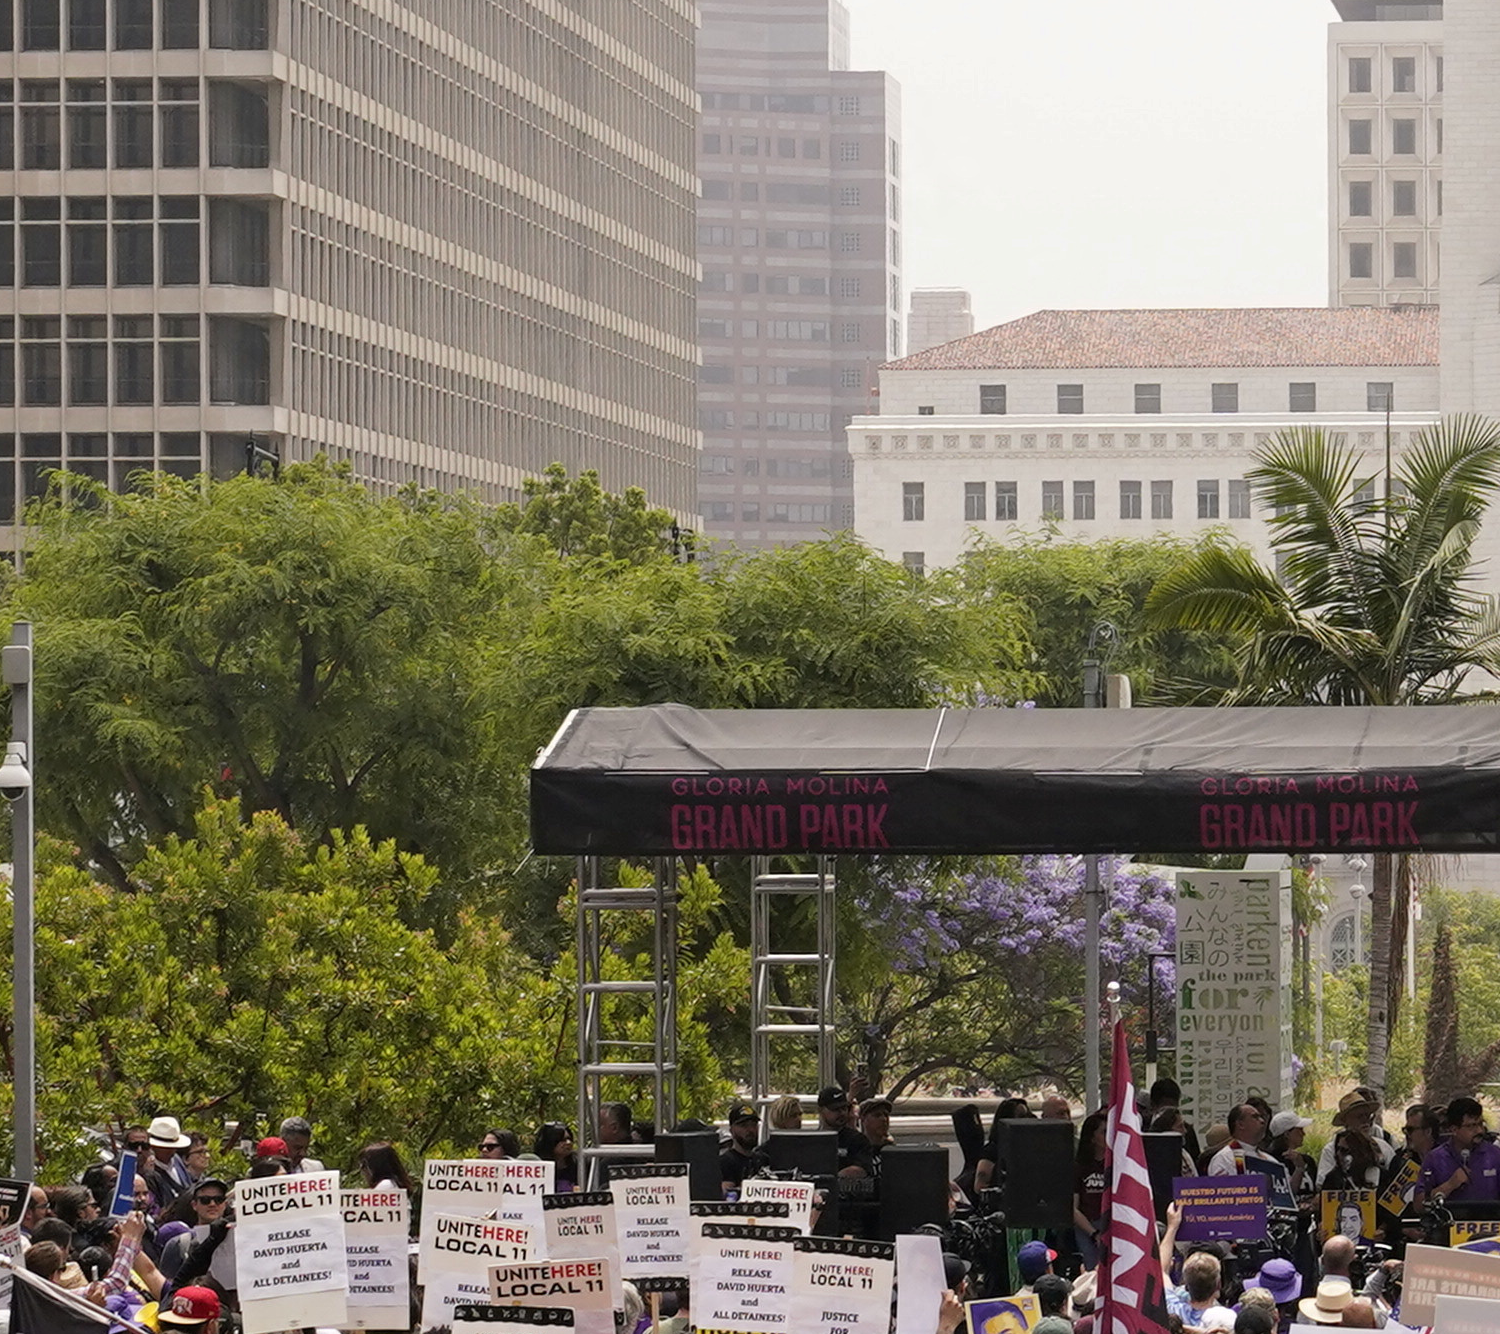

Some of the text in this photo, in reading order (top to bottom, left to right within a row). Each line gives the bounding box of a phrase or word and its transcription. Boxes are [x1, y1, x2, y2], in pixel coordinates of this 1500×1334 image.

[672, 777, 888, 795] GLORIA MOLINA
[1201, 775, 1419, 795] GLORIA MOLINA
[672, 804, 890, 850] GRAND PARK
[1201, 801, 1420, 848] GRAND PARK
[1207, 881, 1230, 967] みんなの
[1179, 908, 1205, 965] 公園
[1198, 968, 1276, 985] the park
[1180, 978, 1249, 1010] for
[427, 1179, 498, 1193] LOCAL 11
[1180, 1188, 1215, 1196] NUESTRO
[1217, 1187, 1247, 1195] FUTURO
[1382, 1167, 1415, 1204] FREE
[242, 1194, 332, 1216] LOCAL 11
[625, 1194, 676, 1206] LOCAL 11
[268, 1229, 311, 1242] RELEASE
[557, 1223, 604, 1236] LOCAL 11
[1456, 1223, 1500, 1235] FREE
[253, 1242, 327, 1259] DAVID HUERTA
[434, 1236, 528, 1261] LOCAL 11
[281, 1259, 300, 1270] and
[730, 1268, 772, 1279] RELEASE
[810, 1274, 873, 1290] LOCAL 11
[253, 1277, 271, 1288] ALL
[496, 1280, 604, 1298] LOCAL 11
[820, 1312, 860, 1323] JUSTICE
